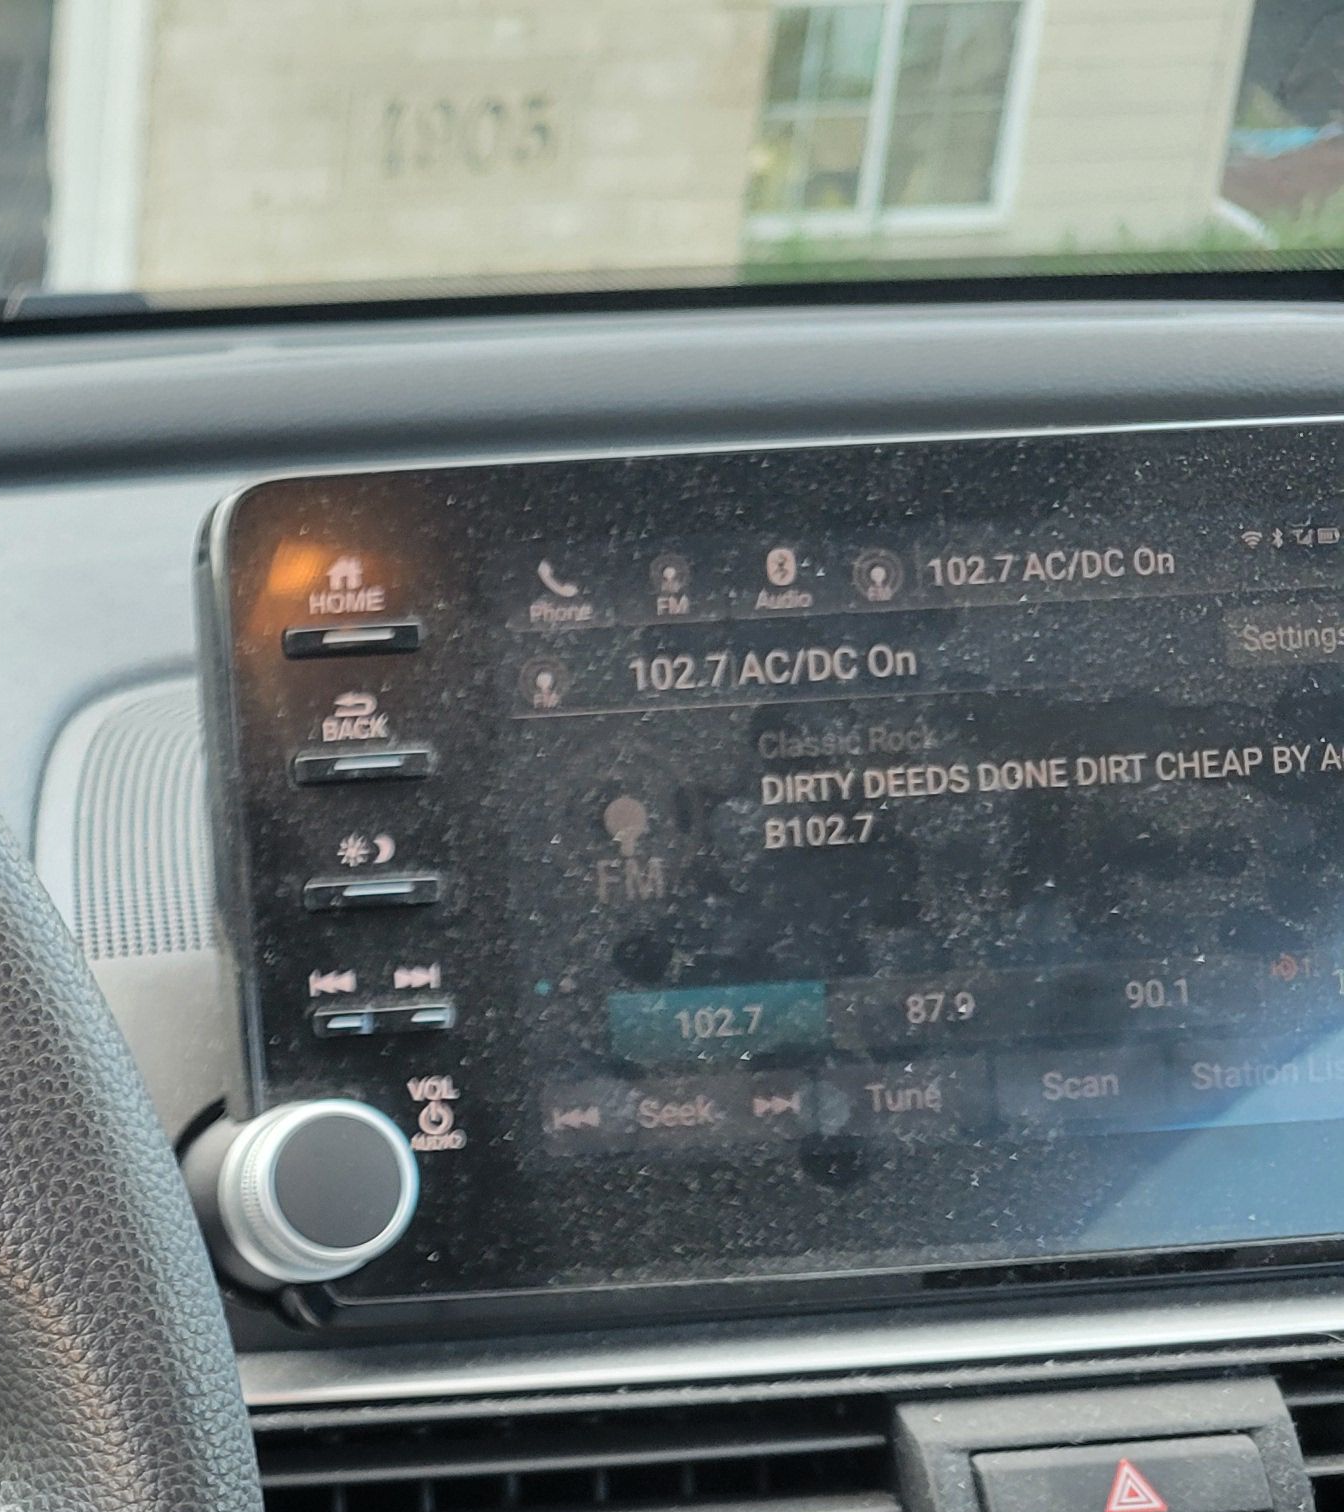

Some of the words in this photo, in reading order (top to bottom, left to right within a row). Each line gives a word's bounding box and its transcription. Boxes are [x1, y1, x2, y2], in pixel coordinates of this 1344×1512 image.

[928, 552, 1012, 586] 102.7
[1023, 551, 1125, 583] AC/DC
[1134, 547, 1176, 575] On
[309, 586, 386, 615] HOME
[629, 655, 727, 691] 102.7
[738, 646, 857, 686] AC/DC
[867, 645, 916, 679] On
[322, 712, 387, 741] BACK
[758, 729, 860, 760] Classic
[867, 724, 935, 754] Rock
[762, 770, 853, 806] DIRTY
[863, 764, 970, 800] DEEDS
[977, 757, 1069, 791] DONE
[1076, 754, 1147, 787] DIRT
[1155, 747, 1263, 782] CHEAP
[1273, 744, 1311, 774] BY
[764, 814, 874, 849] B102.7
[905, 992, 976, 1025] 87.9
[1125, 979, 1189, 1010] 90.1
[675, 1005, 763, 1040] 102.7
[865, 1083, 943, 1113] Tune
[1043, 1070, 1120, 1101] Scan
[638, 1098, 714, 1129] Seek
